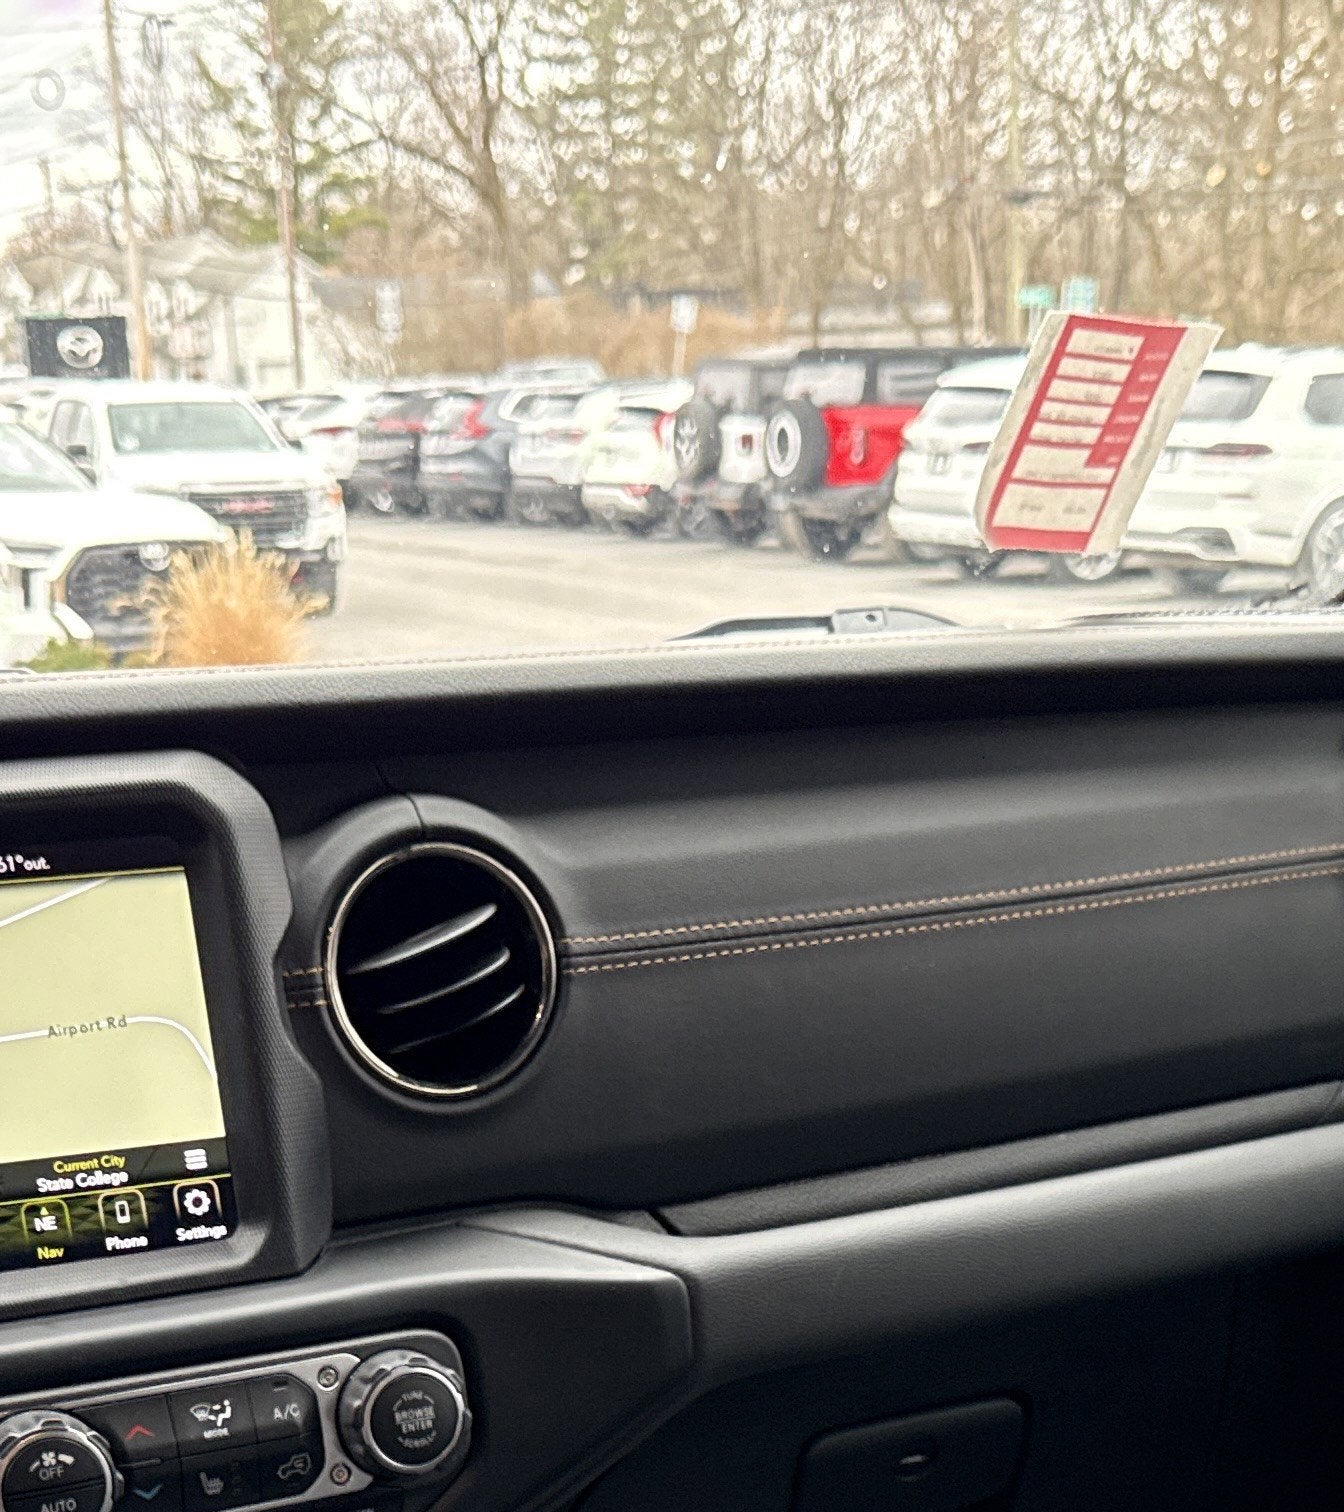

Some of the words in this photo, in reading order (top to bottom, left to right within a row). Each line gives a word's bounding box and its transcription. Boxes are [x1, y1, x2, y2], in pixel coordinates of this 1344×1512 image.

[47, 1021, 103, 1040] Airport
[106, 1014, 128, 1030] Rd
[53, 1158, 99, 1174] Current
[100, 1154, 126, 1170] City
[36, 1175, 73, 1193] State
[74, 1169, 129, 1189] College
[33, 1214, 58, 1232] NE
[176, 1224, 228, 1242] Settings
[105, 1234, 148, 1251] Phone
[36, 1246, 64, 1260] Nav
[274, 1403, 300, 1420] A/C
[39, 1465, 64, 1481] OFF
